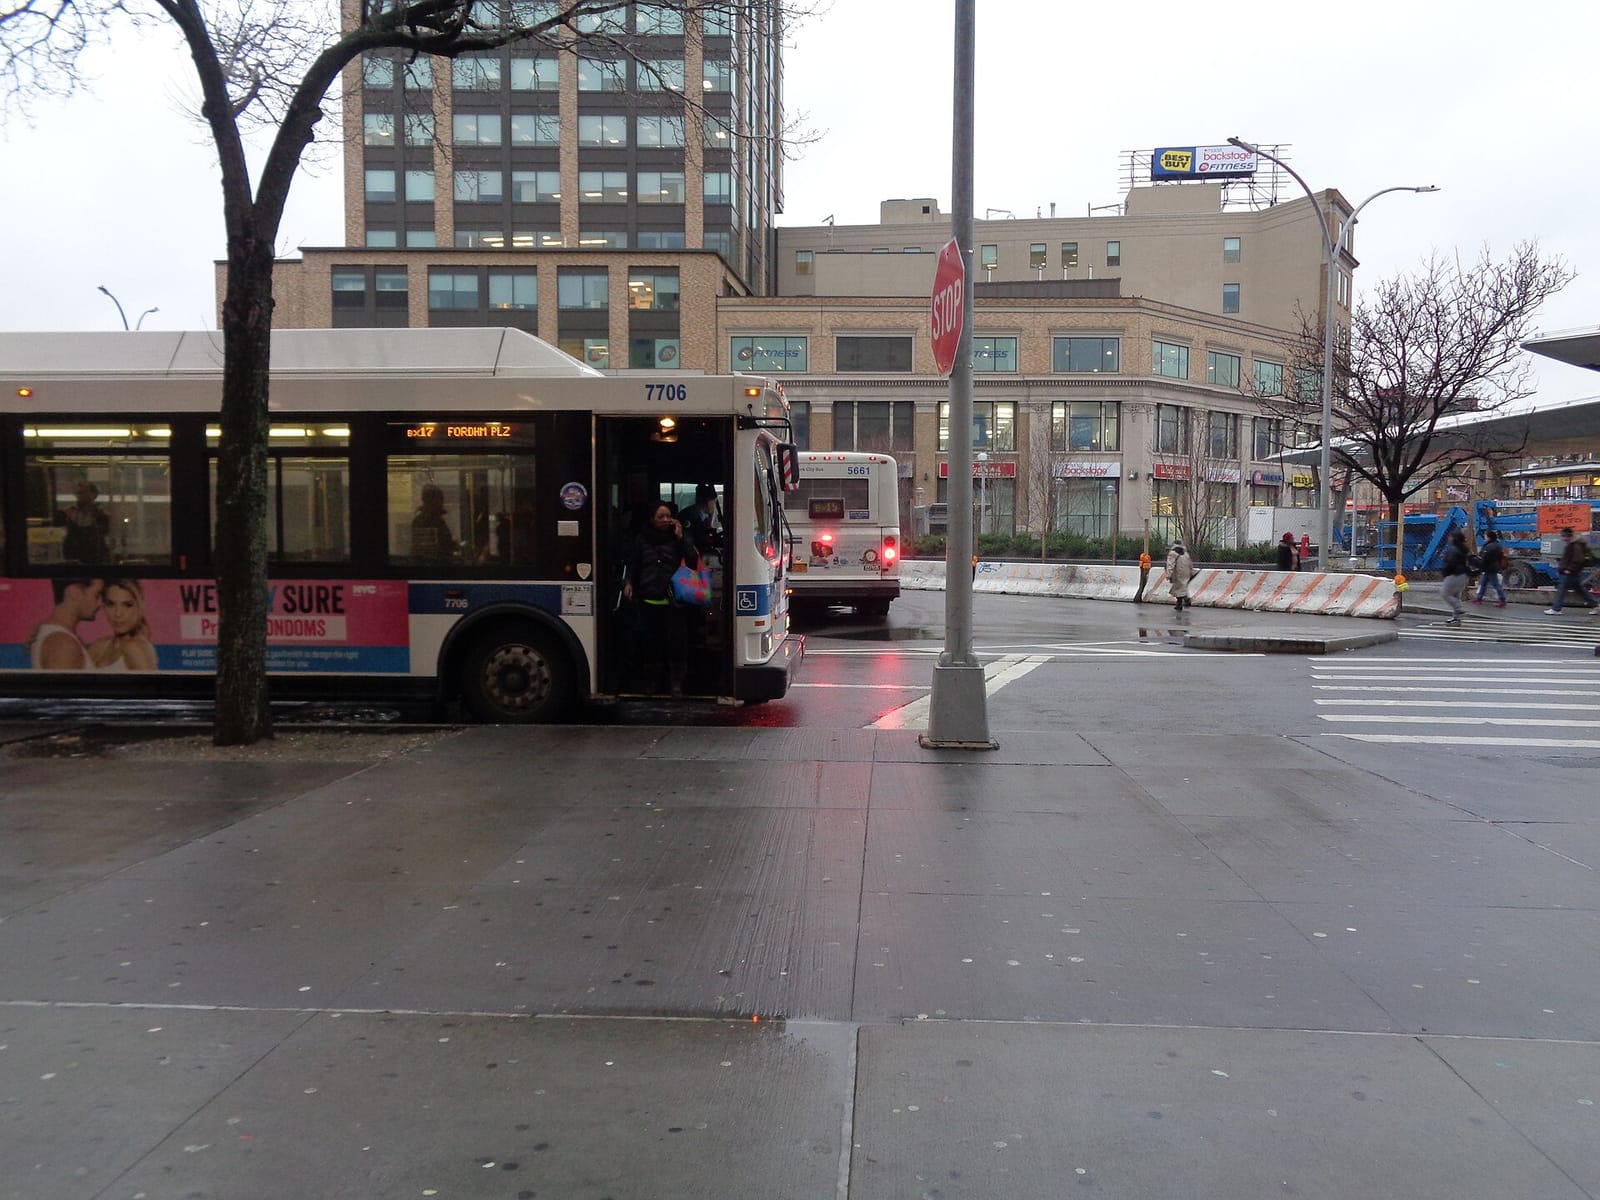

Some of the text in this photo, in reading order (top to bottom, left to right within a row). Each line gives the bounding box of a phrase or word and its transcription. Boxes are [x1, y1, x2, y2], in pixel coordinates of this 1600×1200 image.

[1164, 154, 1191, 162] BEST
[1203, 151, 1253, 161] backstage
[1209, 162, 1255, 170] FITNESS
[933, 278, 961, 340] STOP
[973, 350, 1009, 359] TNESS
[645, 383, 687, 401] 7706
[447, 426, 488, 437] FORDHM
[490, 426, 511, 437] PLZ
[847, 466, 870, 475] 5661
[283, 586, 344, 614] SURE
[445, 598, 468, 608] 7706
[201, 619, 326, 637] Pr ONDOMS
